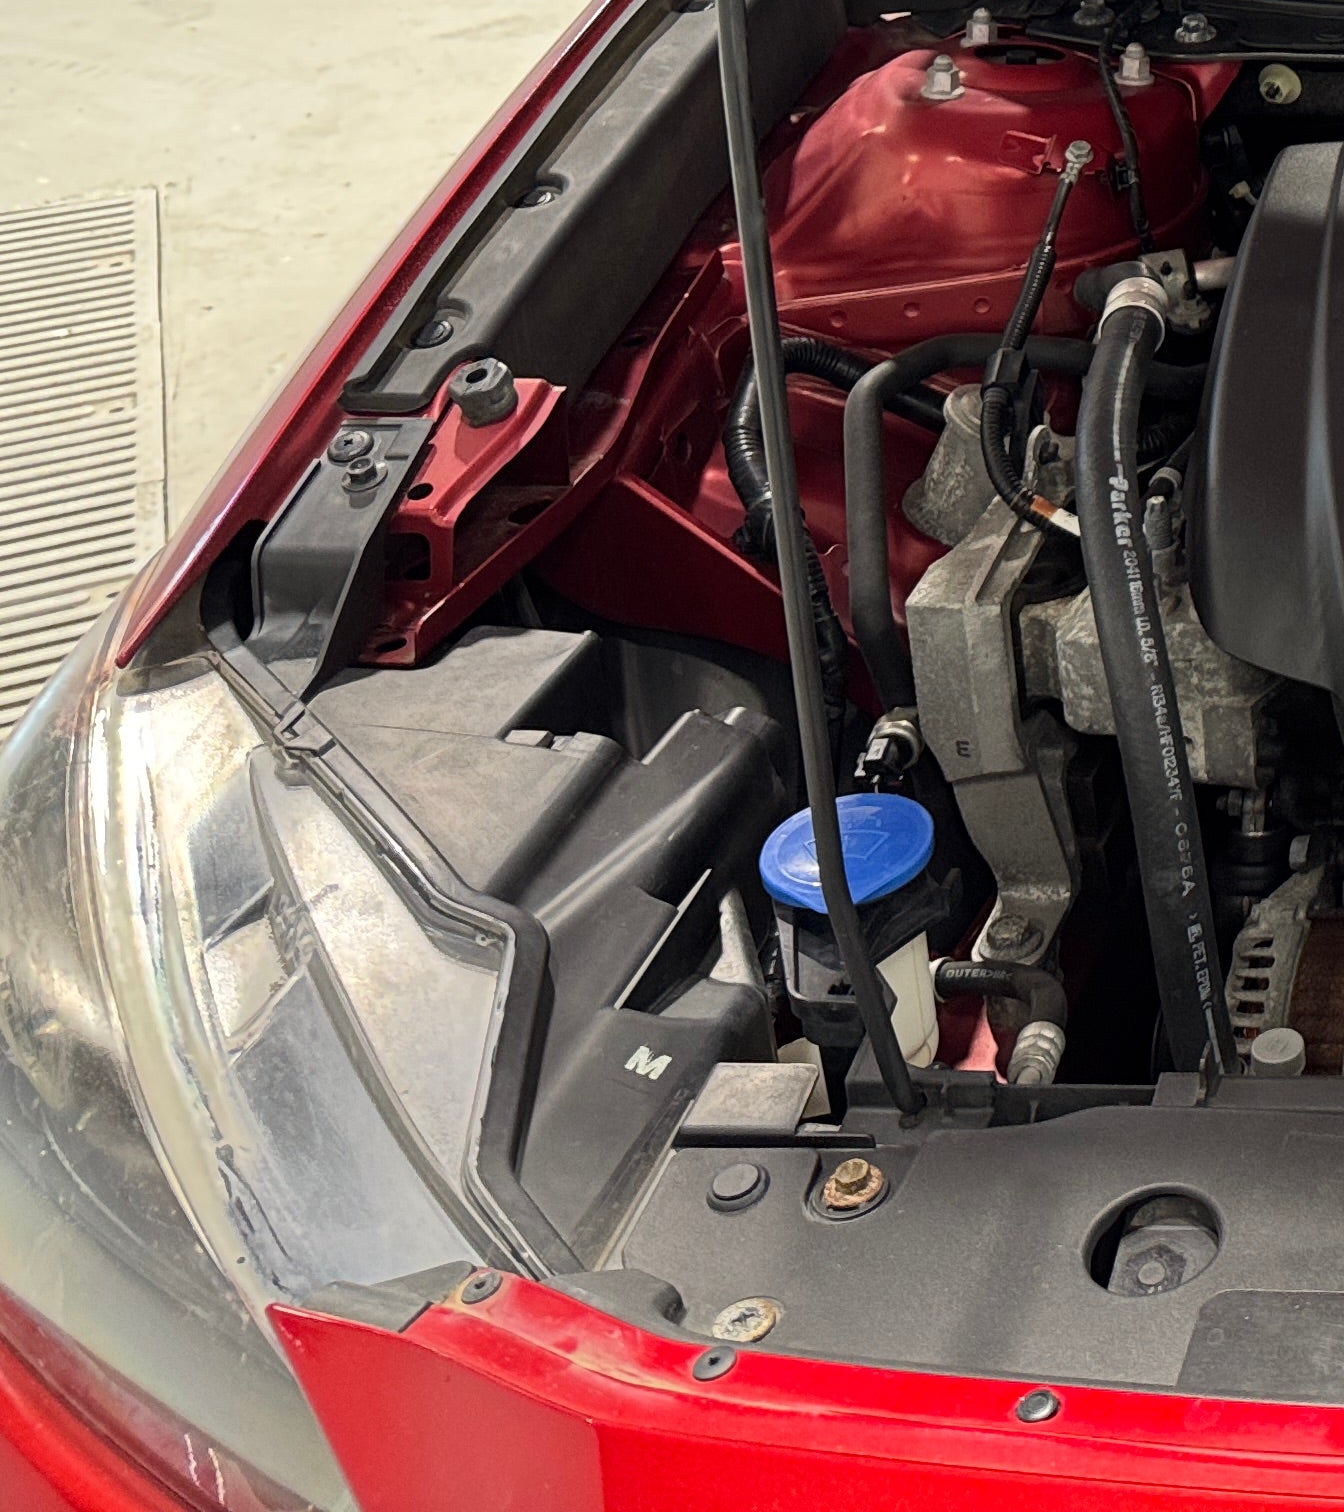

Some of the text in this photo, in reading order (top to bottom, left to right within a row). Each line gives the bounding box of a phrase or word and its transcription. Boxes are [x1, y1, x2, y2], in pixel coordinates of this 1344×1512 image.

[1109, 476, 1133, 548] Parker
[955, 740, 970, 758] E
[624, 1045, 673, 1080] M
